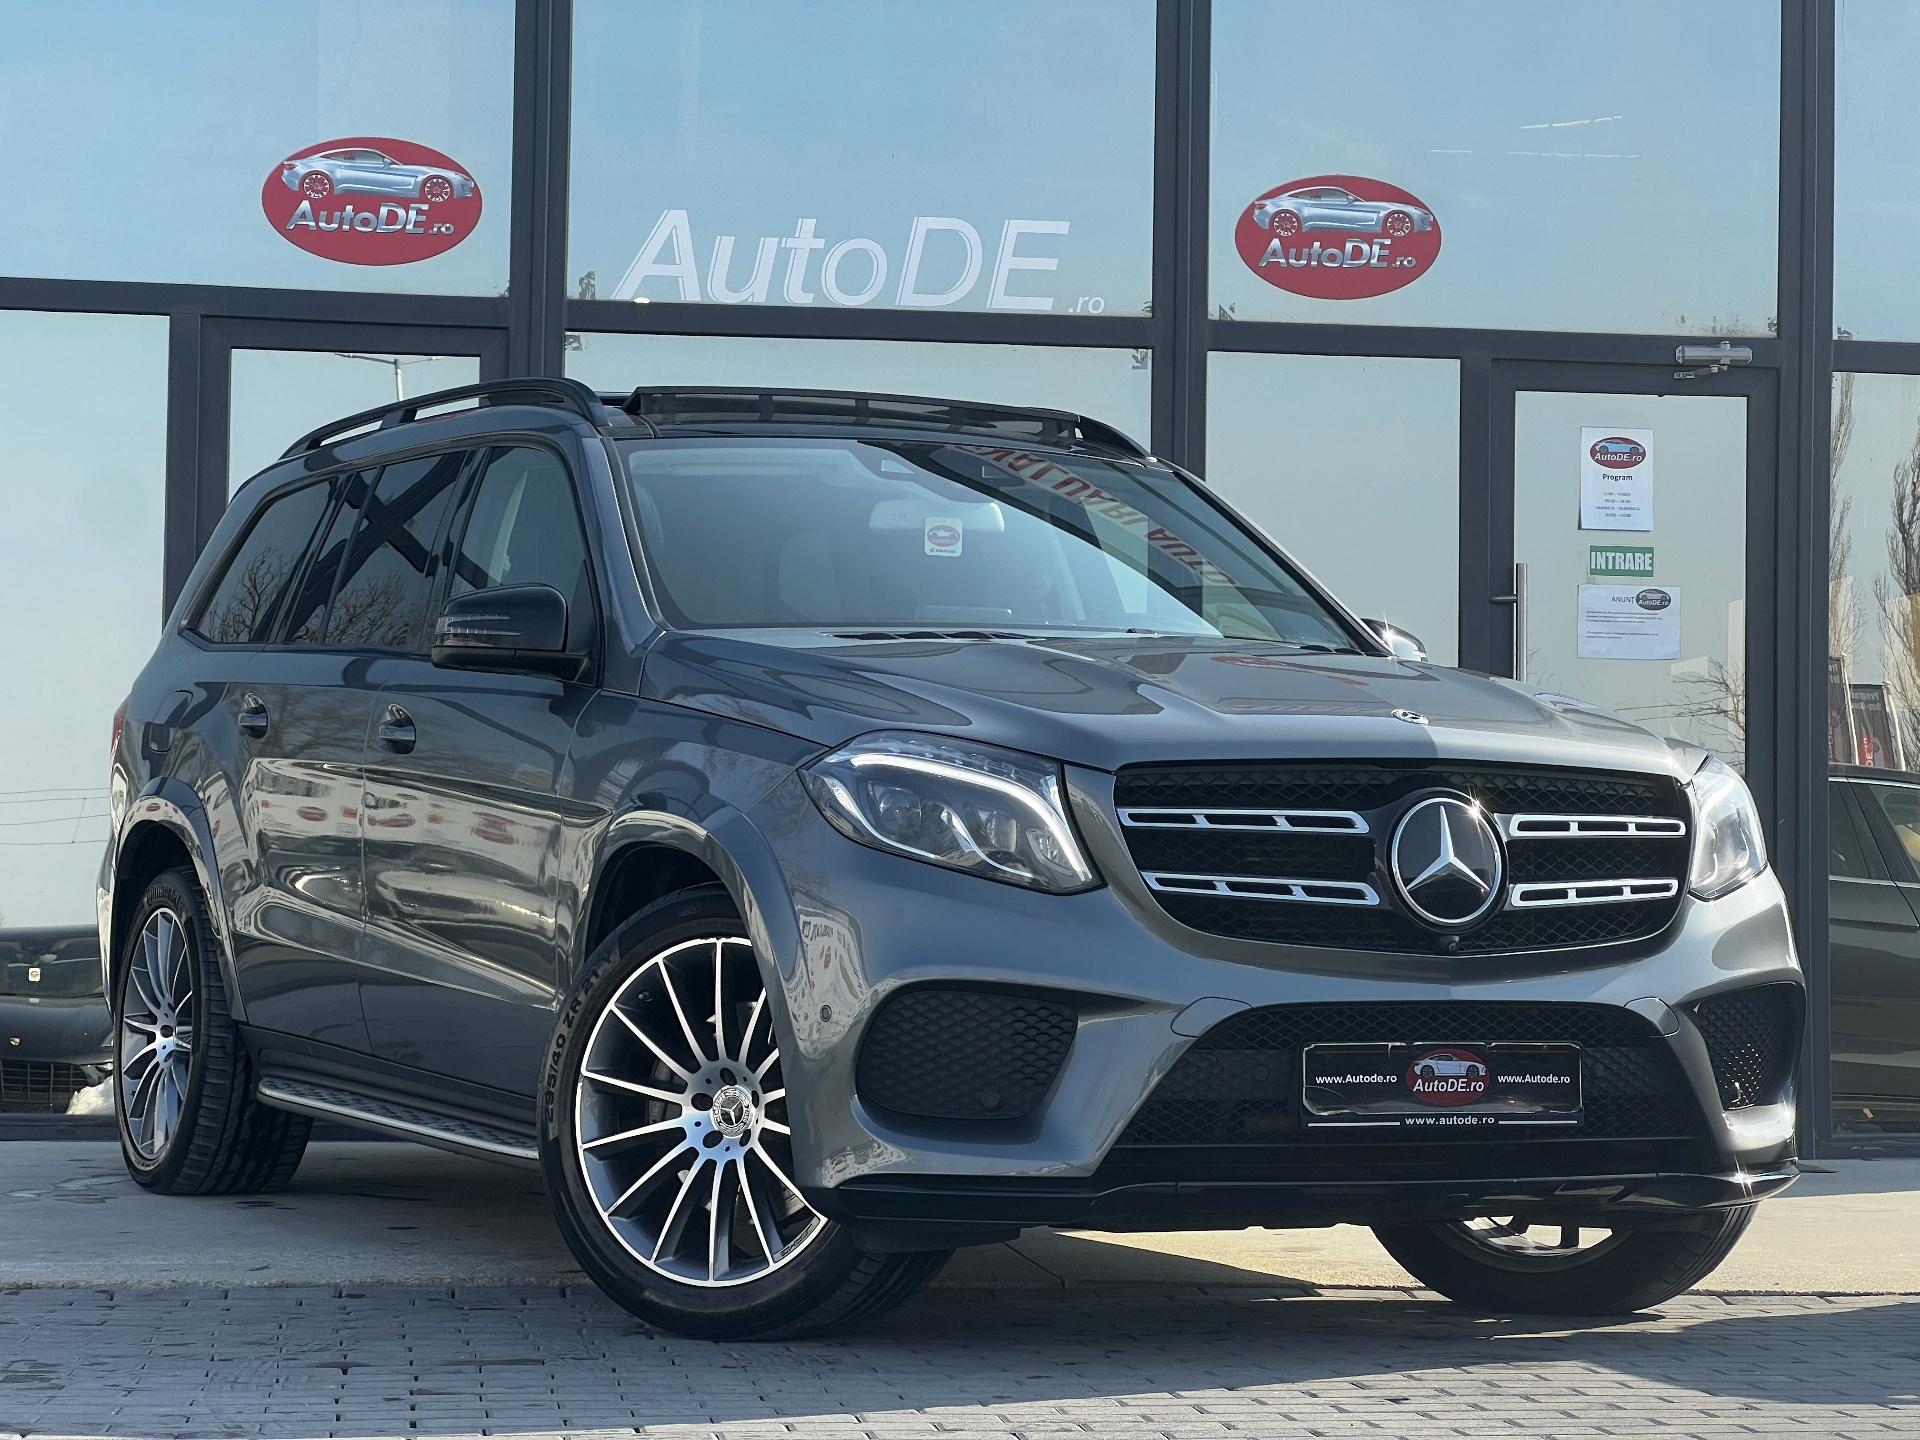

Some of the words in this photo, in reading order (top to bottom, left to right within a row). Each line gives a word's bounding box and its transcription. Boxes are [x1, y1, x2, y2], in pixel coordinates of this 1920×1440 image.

[1594, 452, 1643, 462] AutoDE.ro
[1602, 473, 1633, 481] Program
[1591, 551, 1653, 571] INTRARE
[545, 1033, 567, 1124] 295/40
[563, 998, 582, 1028] ZR
[581, 968, 600, 995] 21
[1315, 1073, 1398, 1084] www.Autode.ro
[1412, 1078, 1485, 1093] AutoDE.ro
[1497, 1073, 1571, 1085] www.Autode.ro
[1405, 1115, 1495, 1126] www.autode.ro
